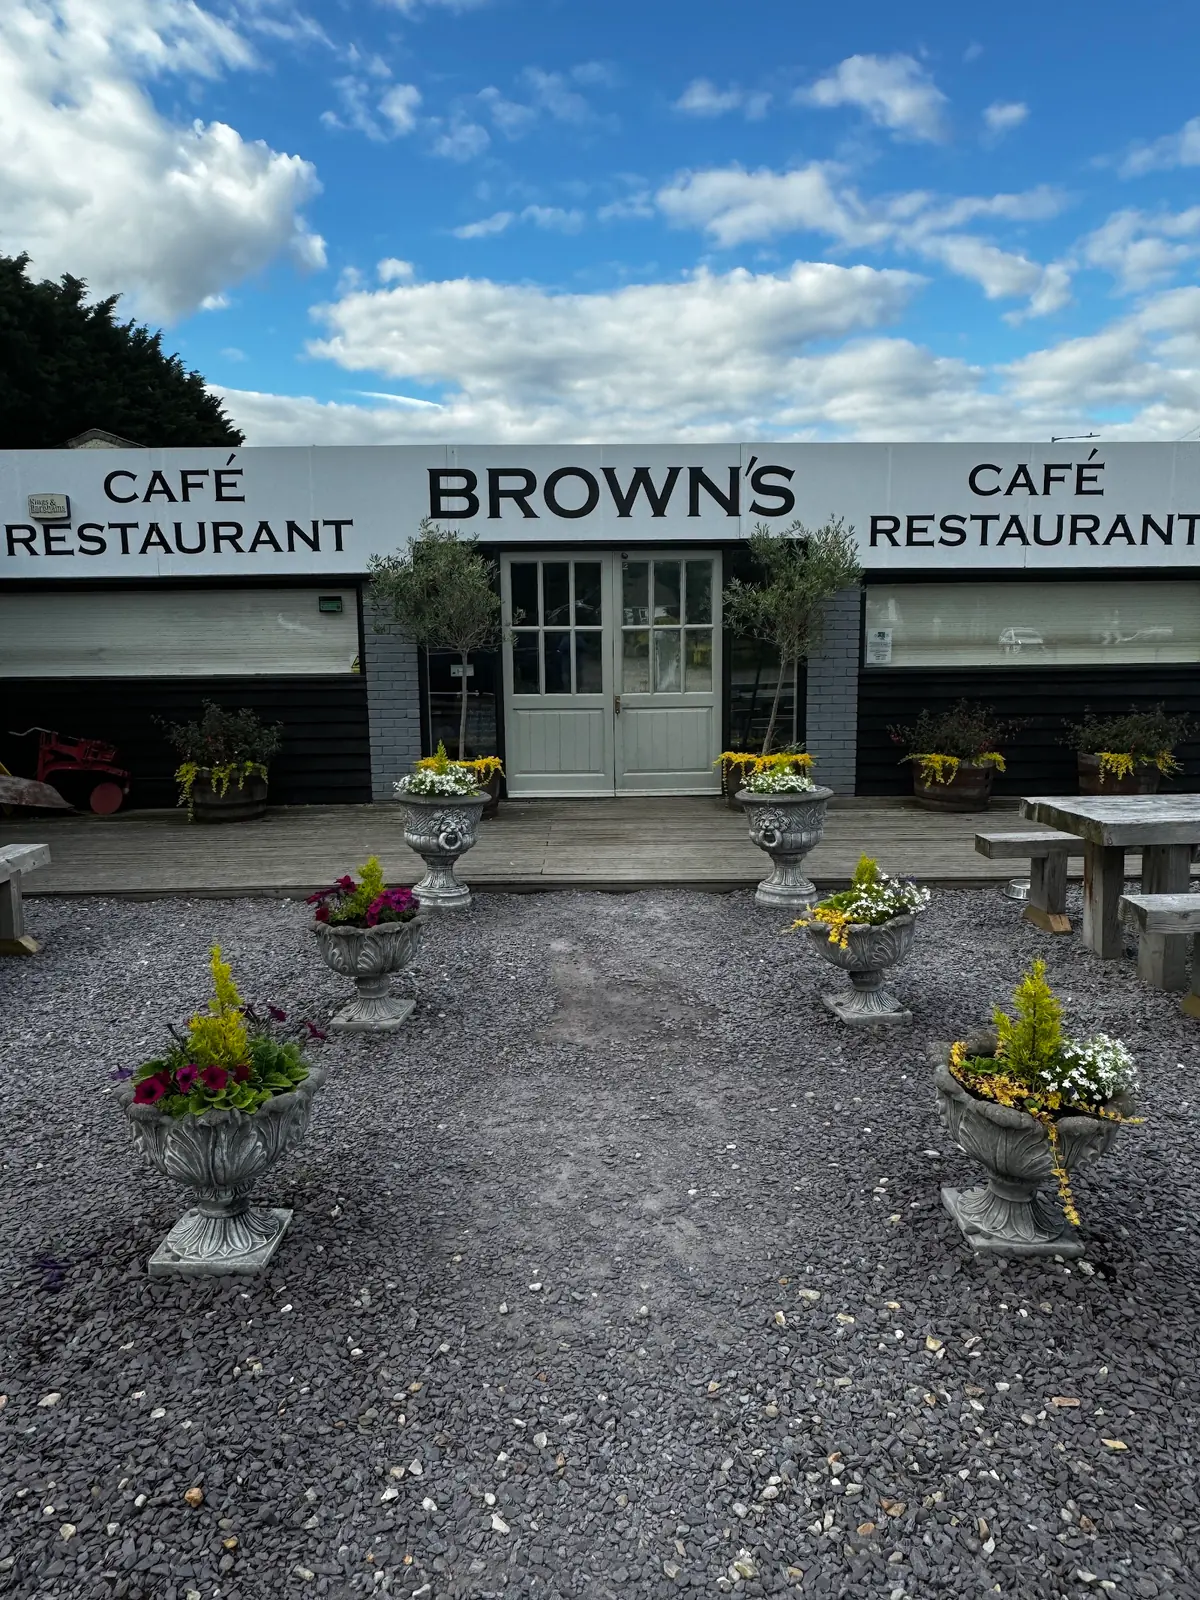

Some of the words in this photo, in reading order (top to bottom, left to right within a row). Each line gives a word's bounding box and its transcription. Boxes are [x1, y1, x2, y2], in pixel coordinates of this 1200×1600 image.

[103, 453, 246, 504] CAFÉ
[426, 455, 796, 519] BROWN'S
[968, 448, 1106, 497] CAFÉ
[4, 519, 354, 557] RESTAURANT
[869, 513, 1200, 548] RESTAURANT
